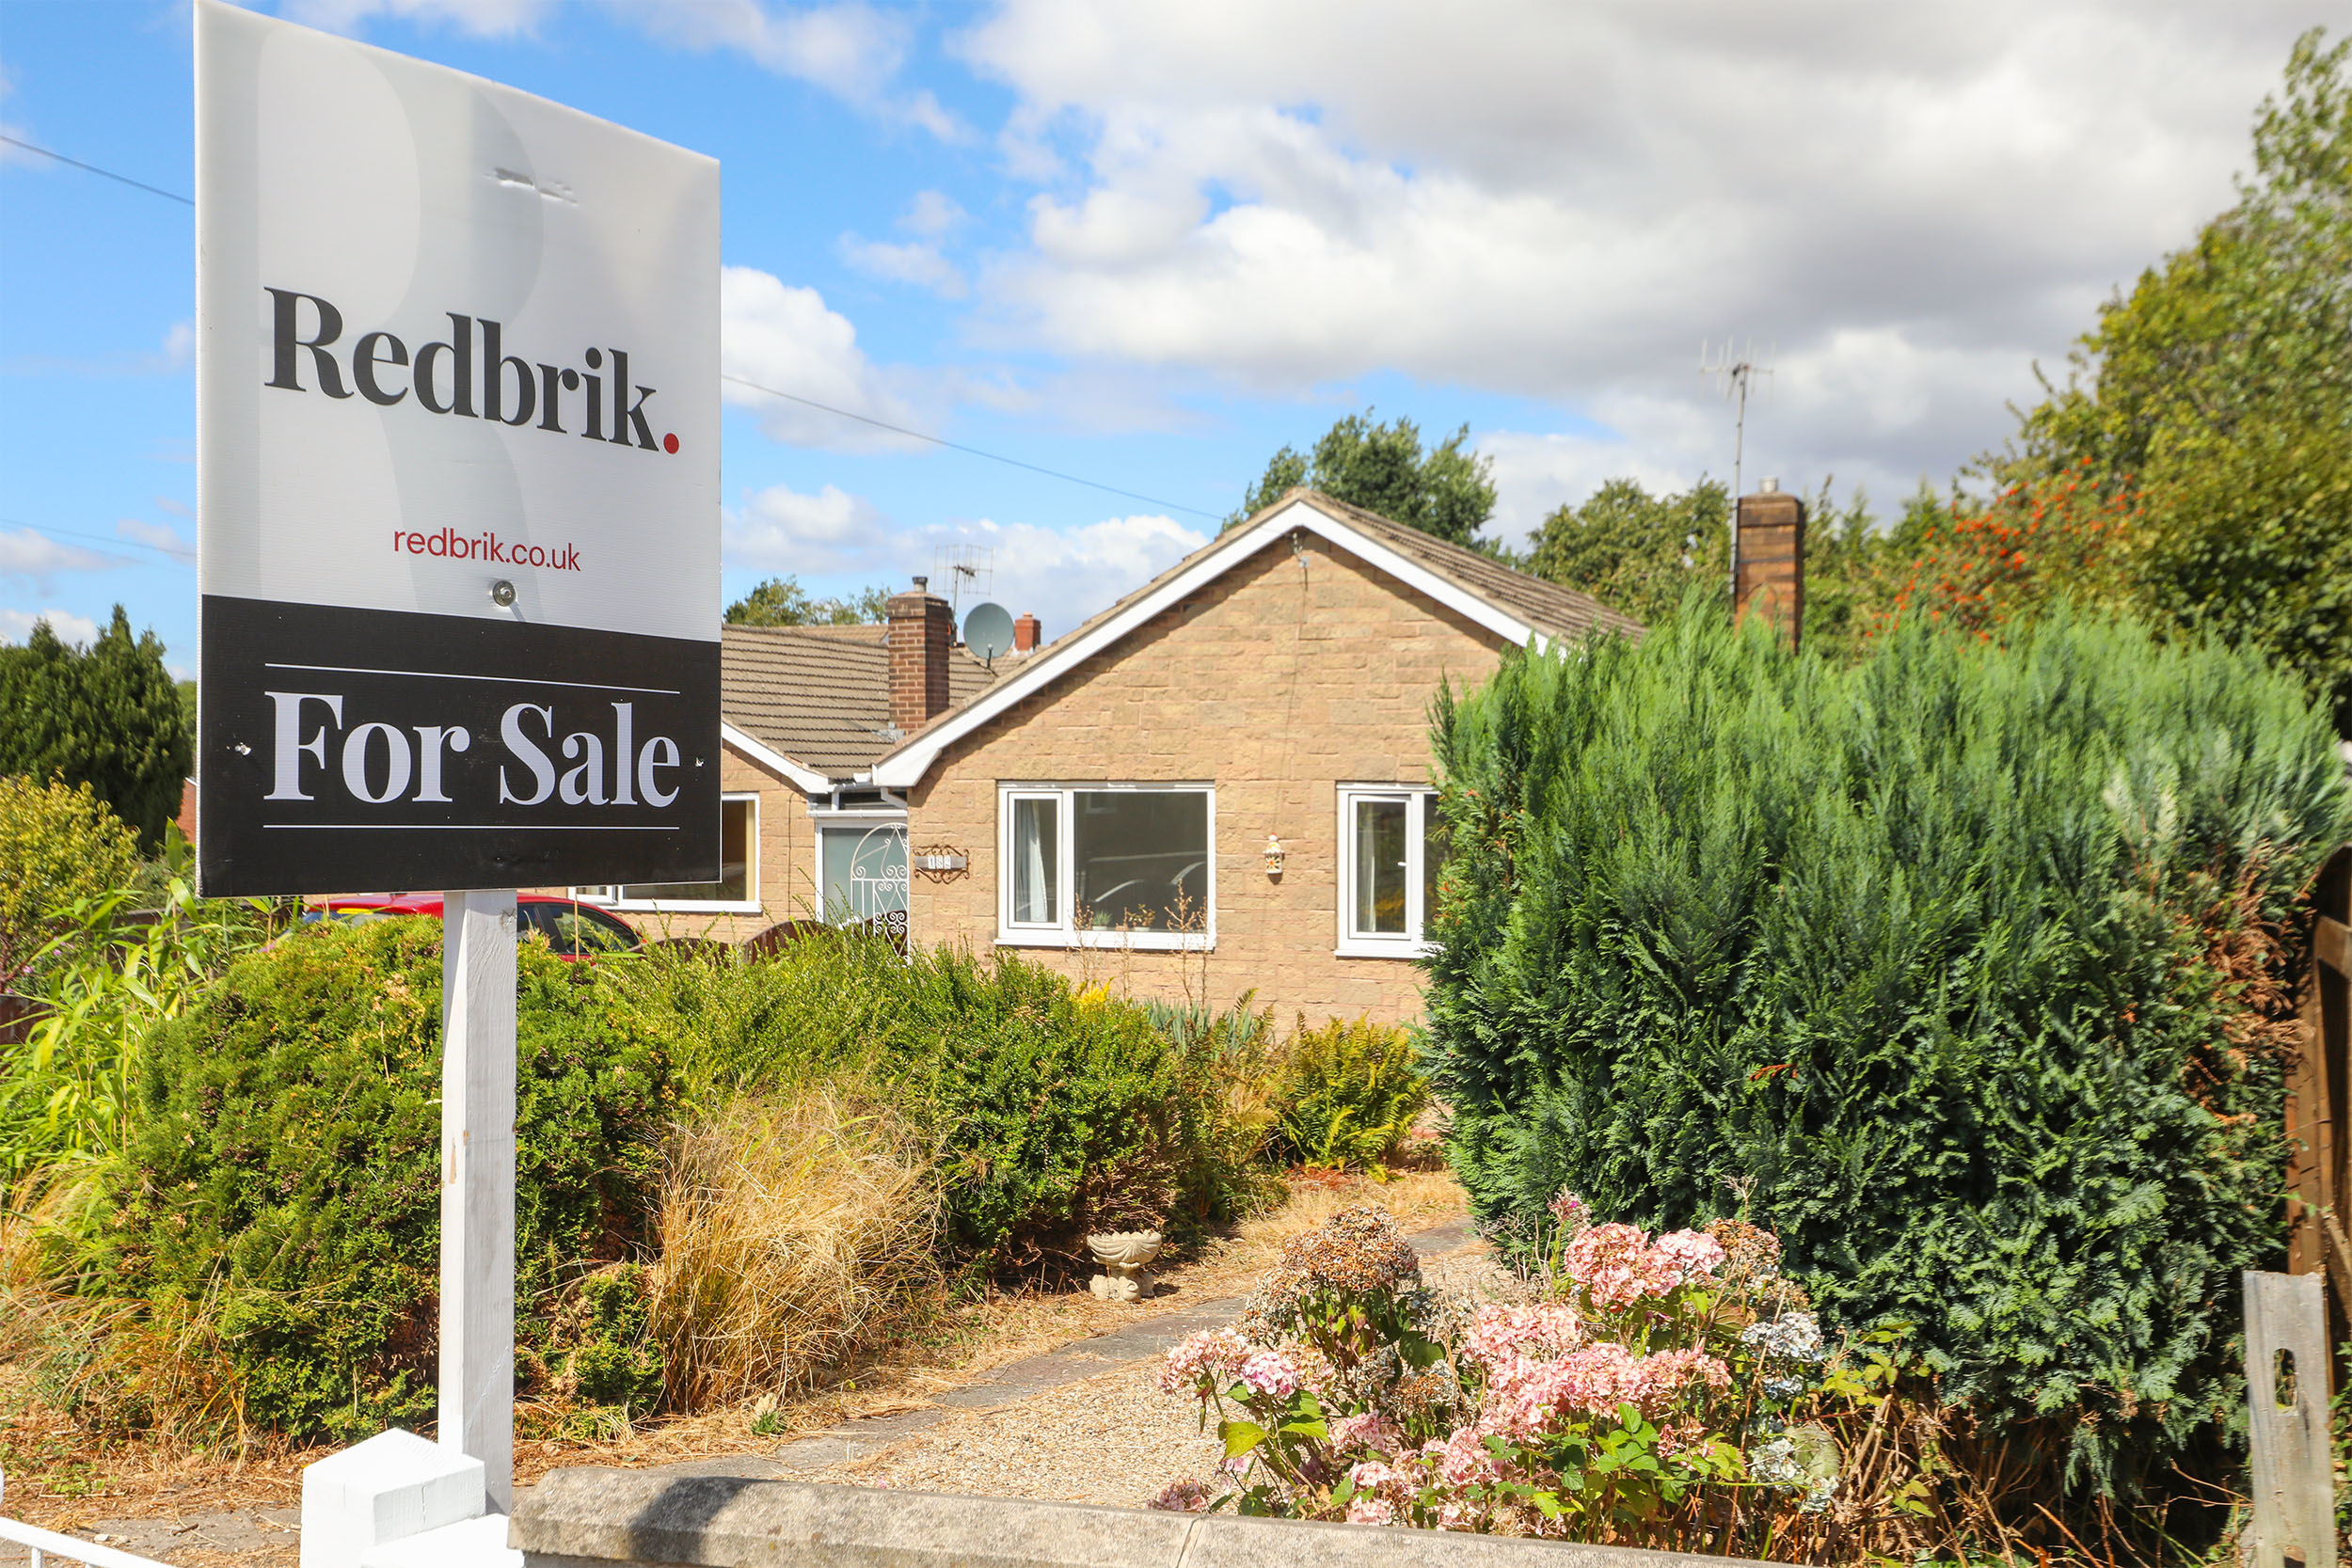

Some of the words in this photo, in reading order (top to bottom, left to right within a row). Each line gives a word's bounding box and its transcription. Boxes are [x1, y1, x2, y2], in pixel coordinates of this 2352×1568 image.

[393, 527, 580, 572] redbrik.co.uk
[263, 691, 470, 803] For
[500, 701, 680, 807] Sale
